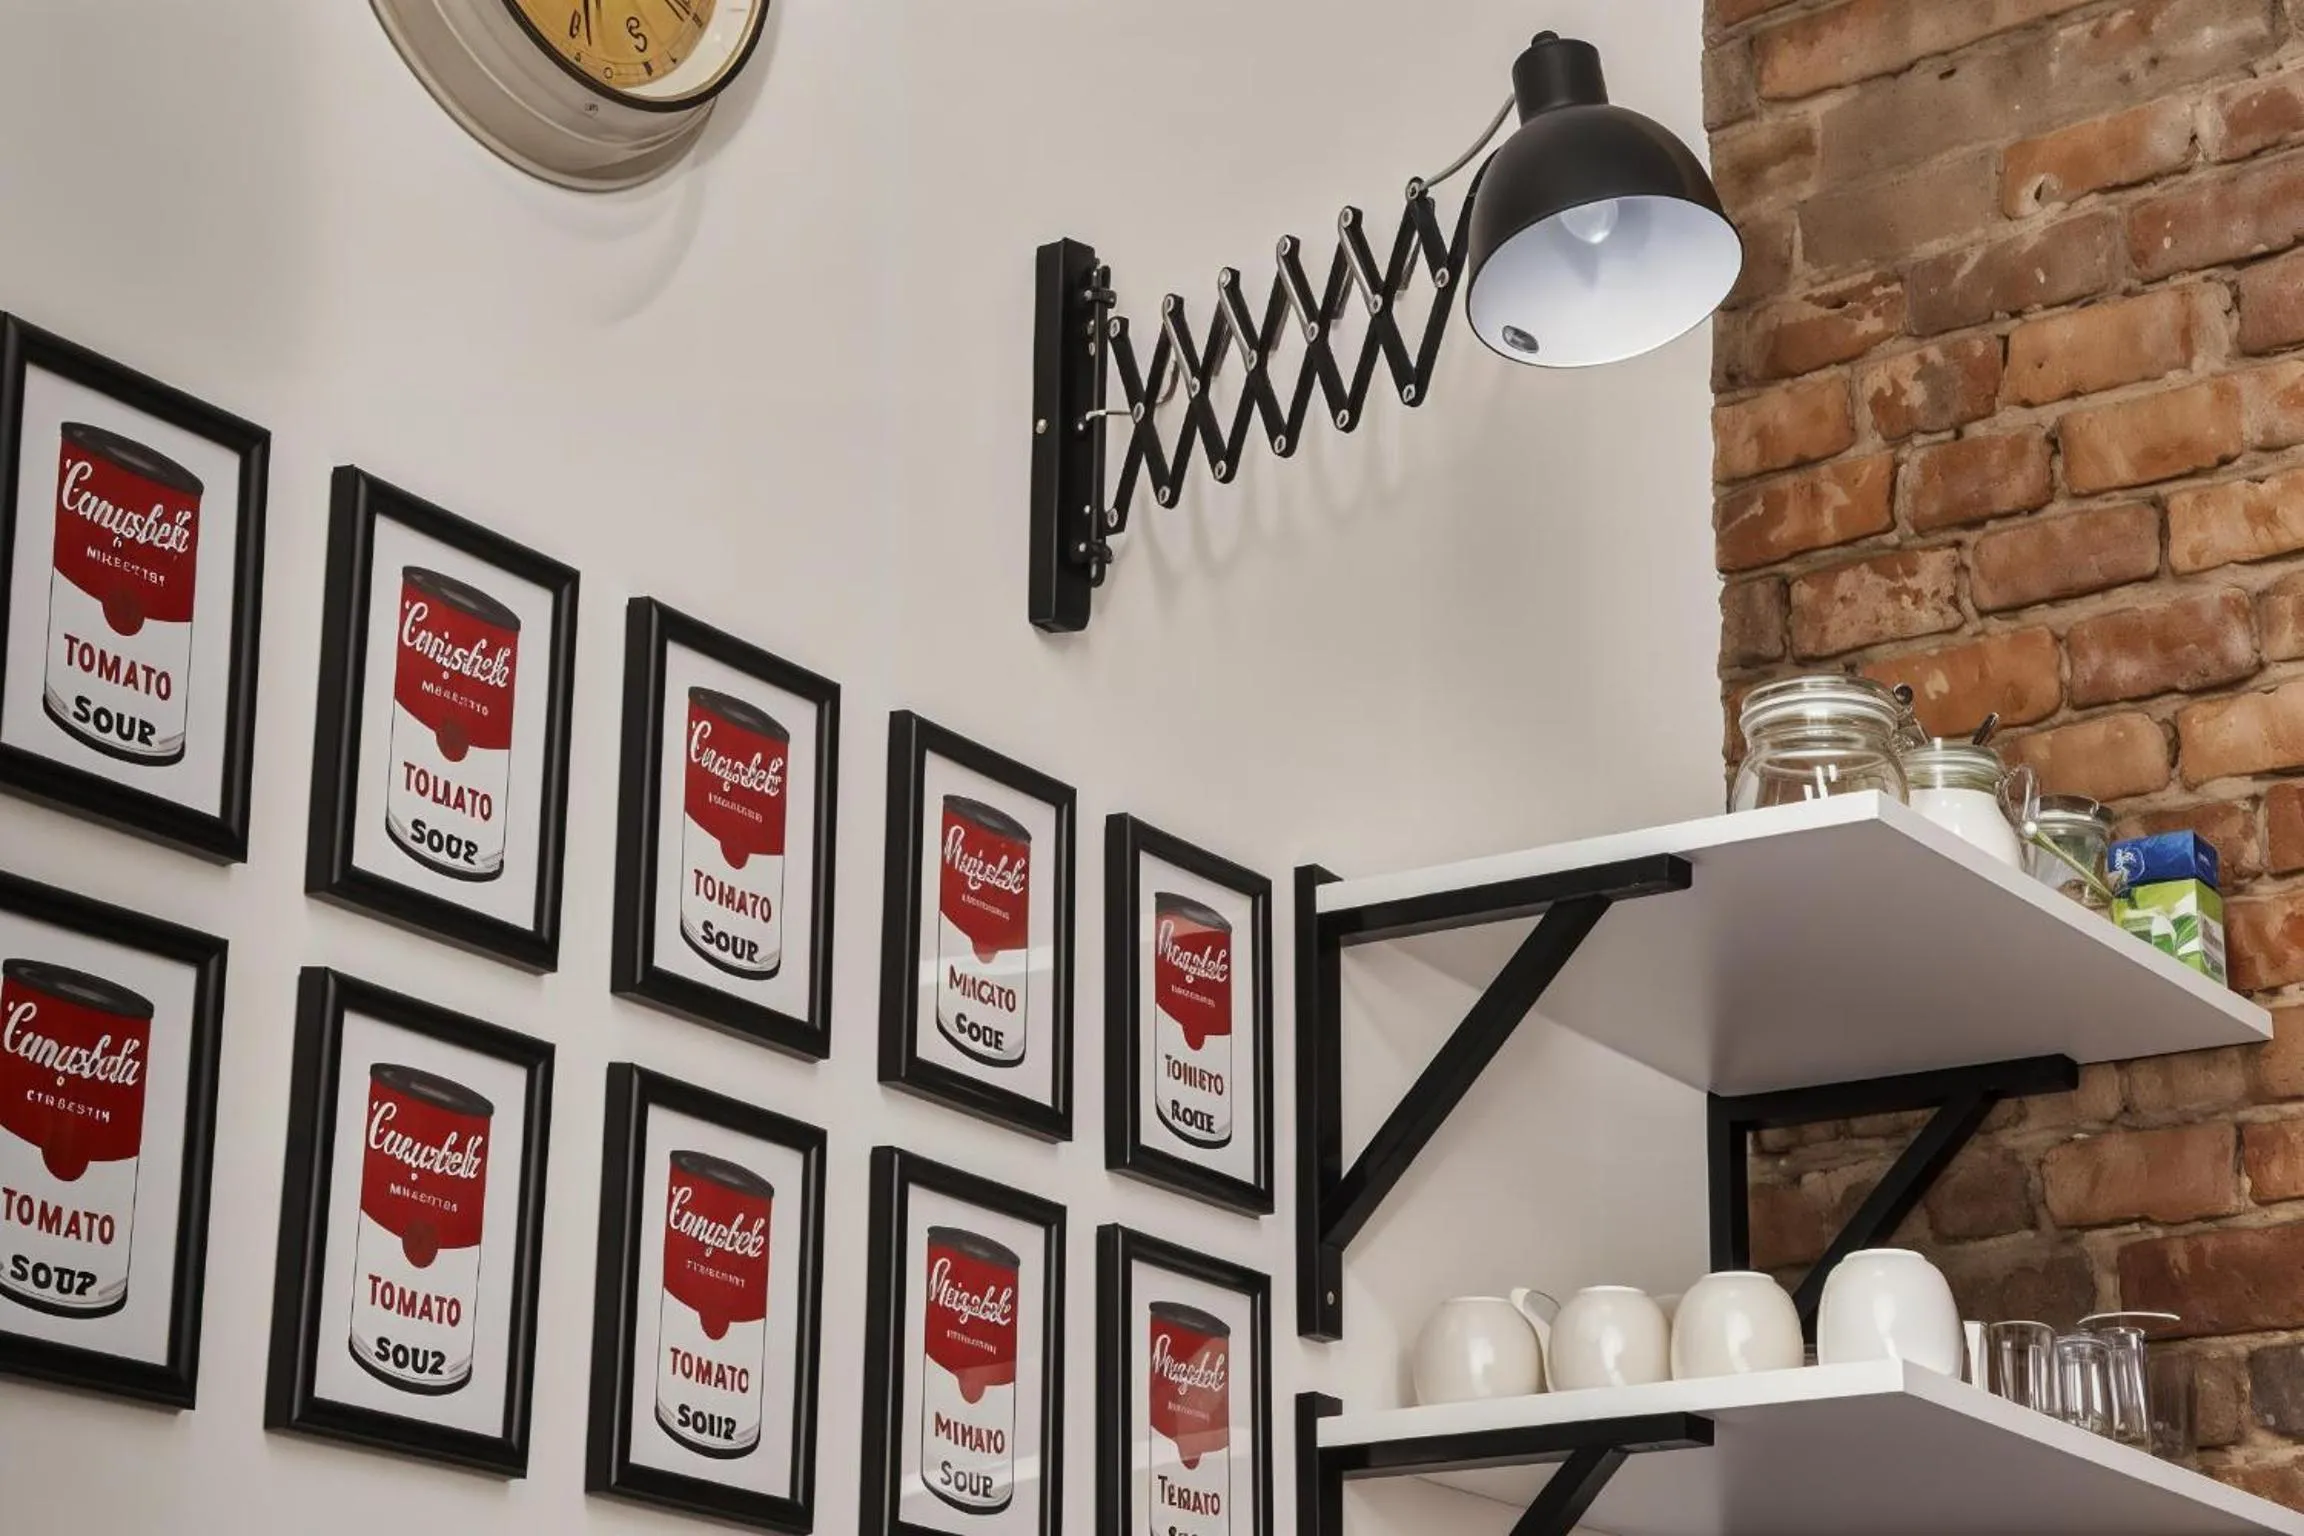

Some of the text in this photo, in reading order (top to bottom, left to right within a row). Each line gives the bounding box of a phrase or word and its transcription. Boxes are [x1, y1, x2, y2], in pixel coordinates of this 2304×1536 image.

[64, 632, 171, 701] TOMATO
[2, 1187, 115, 1245] TOMATO
[368, 1273, 462, 1328] TOMATO
[670, 1346, 749, 1394] TOMATO
